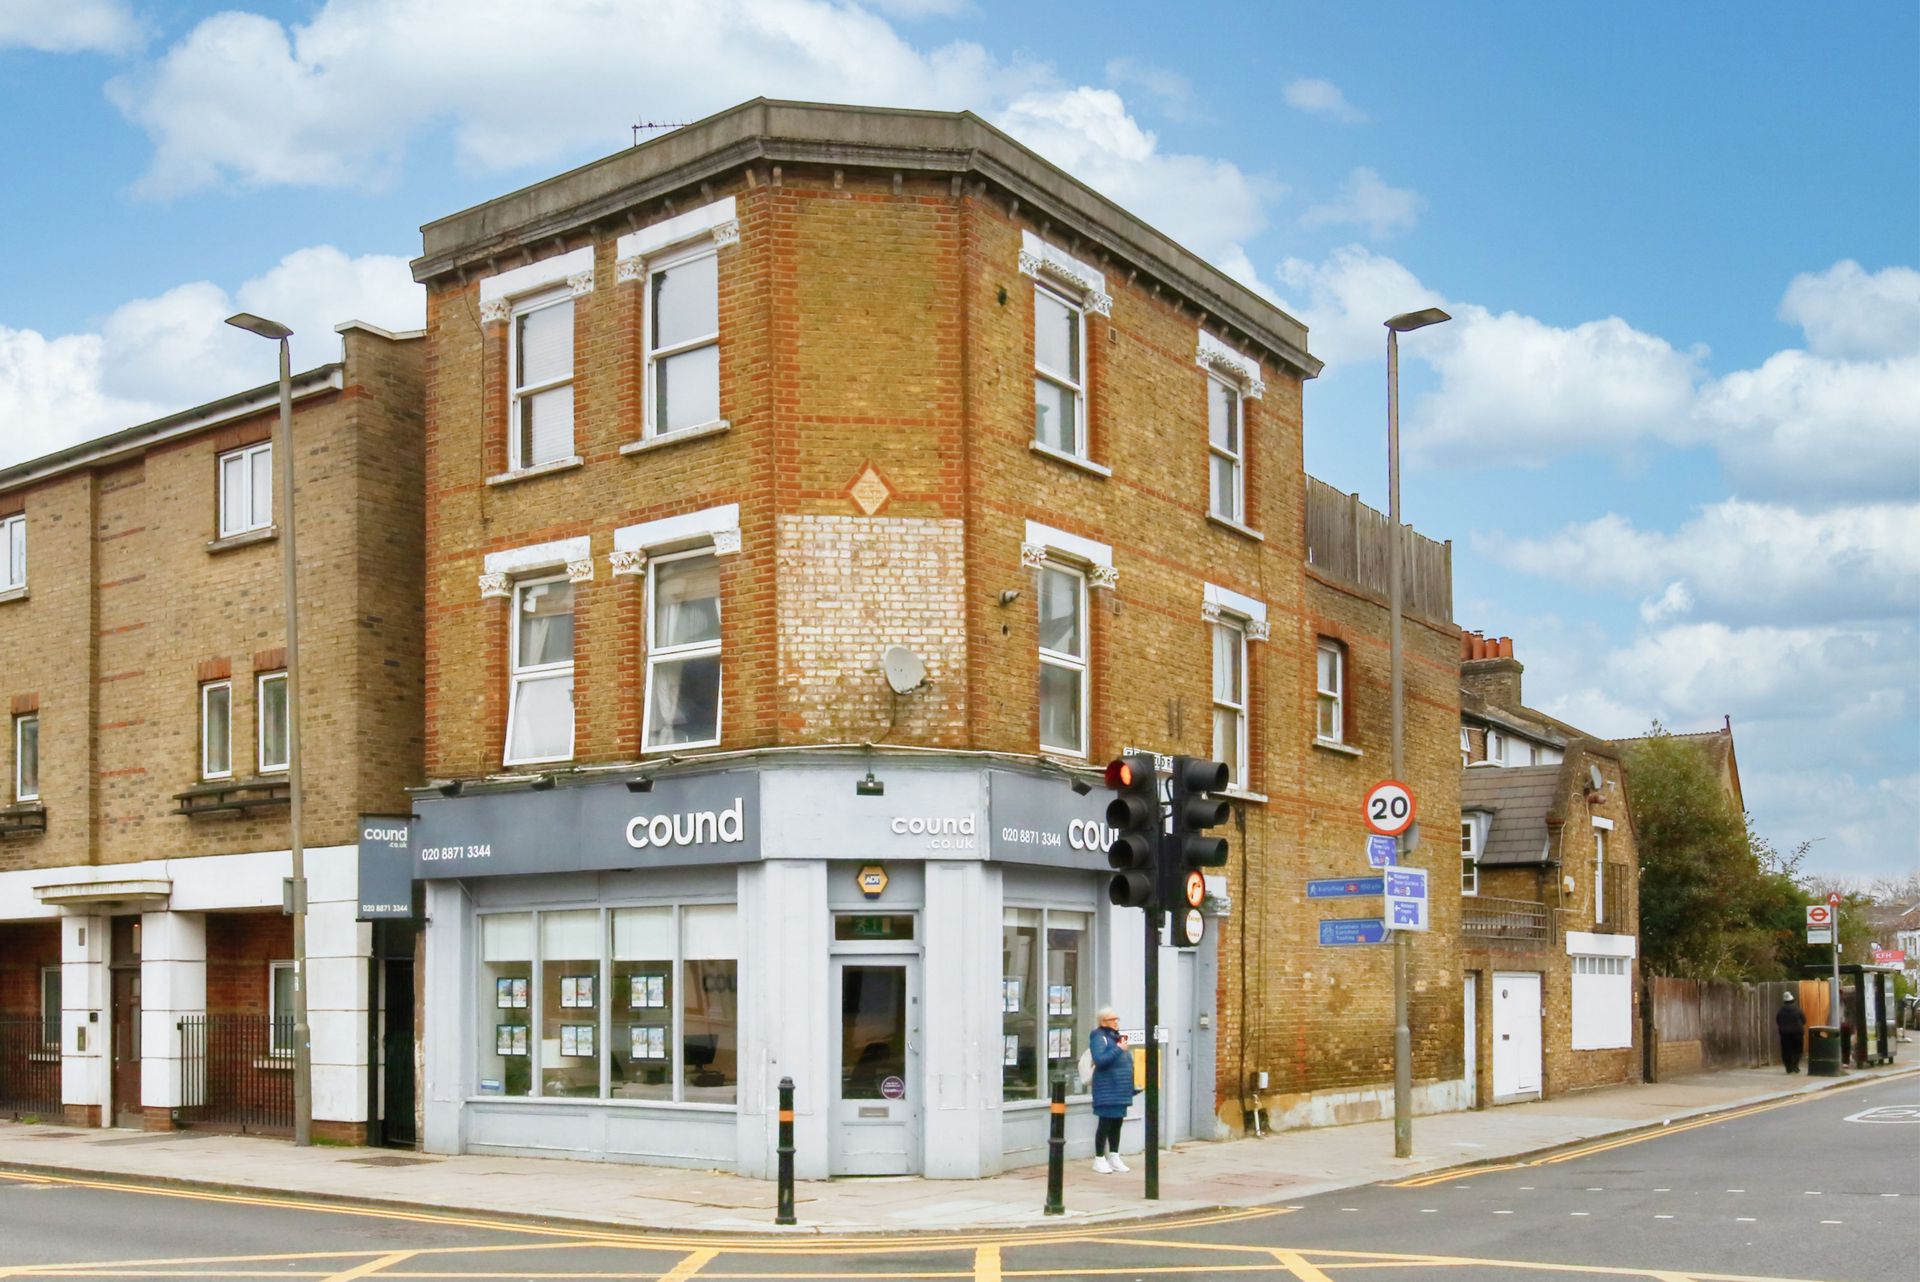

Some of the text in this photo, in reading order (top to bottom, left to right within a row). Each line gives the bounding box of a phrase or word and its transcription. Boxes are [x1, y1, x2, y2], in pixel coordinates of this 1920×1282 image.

[1371, 796, 1408, 820] 20
[625, 797, 744, 849] cound
[891, 813, 976, 836] cound
[364, 827, 408, 841] cound
[1002, 827, 1061, 847] 020 8871 3344
[1068, 818, 1119, 853] cou
[422, 844, 491, 861] 020 8871 3344
[926, 837, 975, 850] .co.uk
[1830, 893, 1839, 902] A
[363, 904, 408, 912] 020 8871 3344
